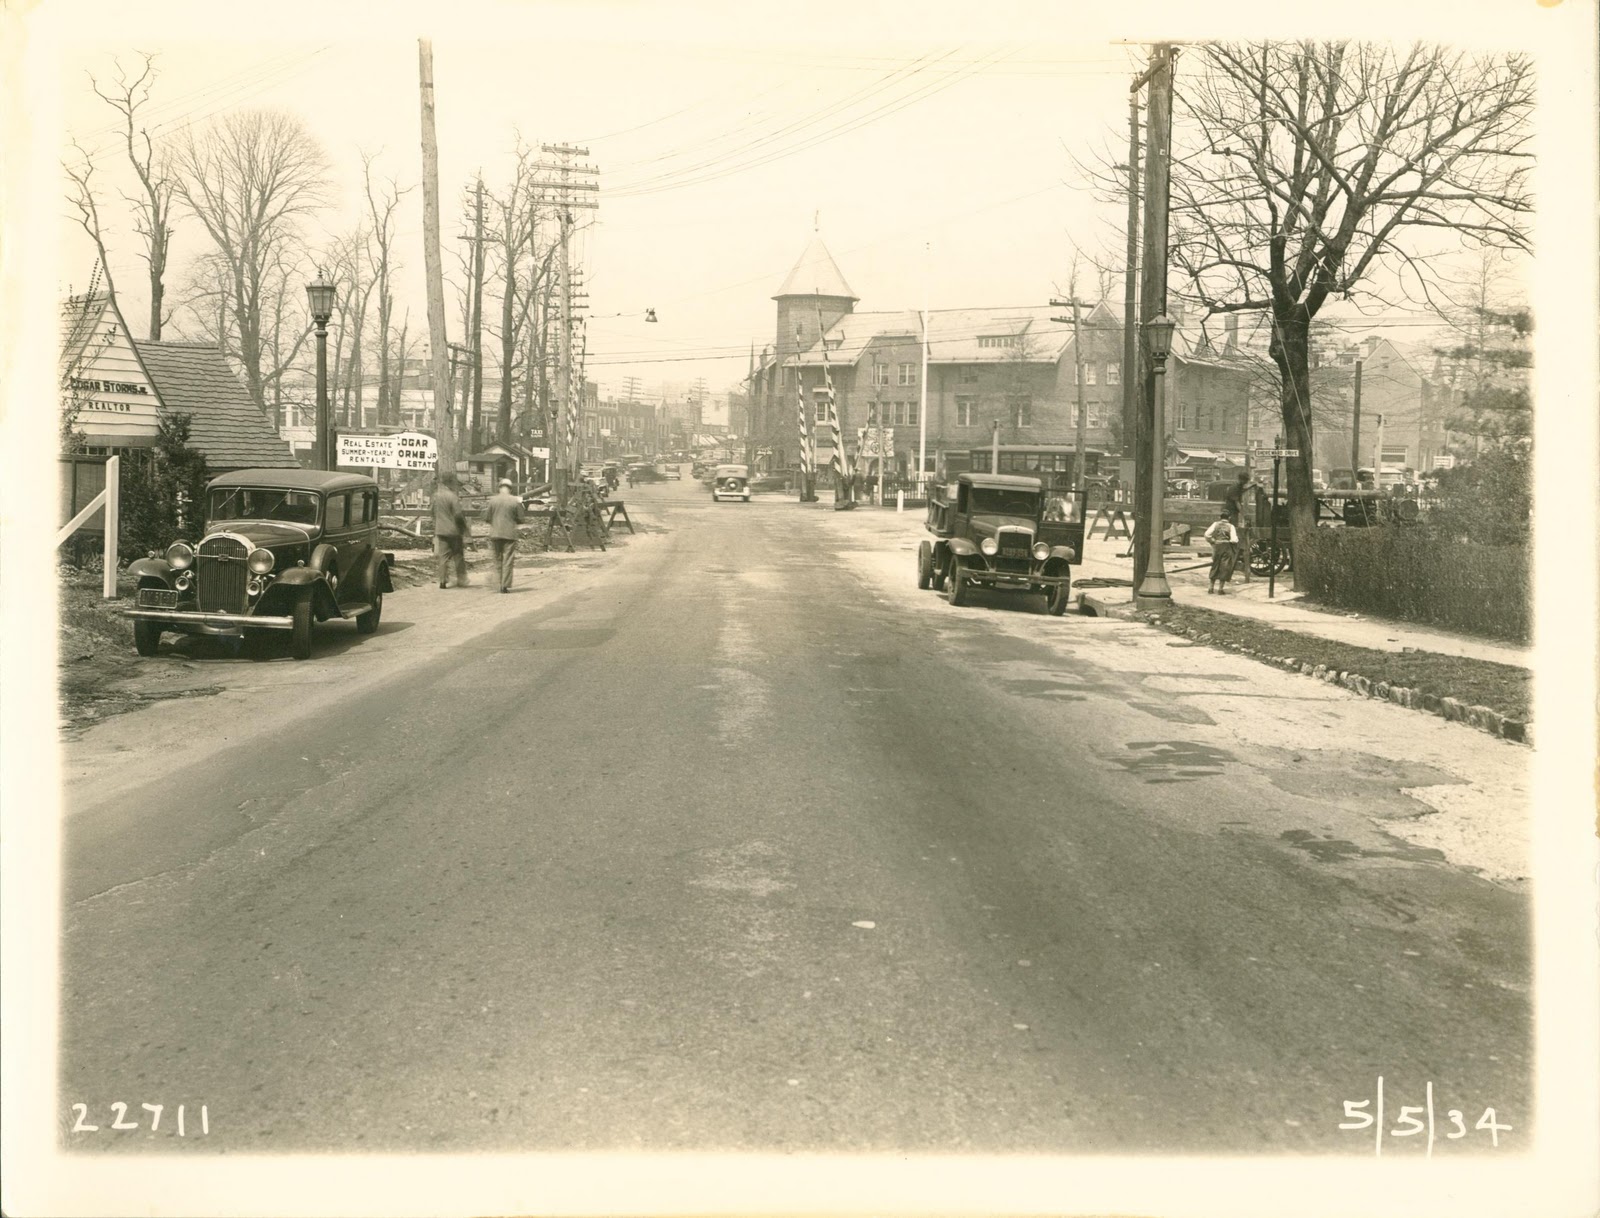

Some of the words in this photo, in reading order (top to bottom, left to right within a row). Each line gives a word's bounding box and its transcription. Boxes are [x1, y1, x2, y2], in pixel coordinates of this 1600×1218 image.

[103, 381, 137, 394] STORMS
[88, 401, 131, 412] REALTOR
[343, 439, 362, 447] REAL
[365, 440, 392, 448] ESTATE
[341, 448, 393, 456] SUMMER-YEARLY
[398, 450, 425, 459] ORMS
[349, 456, 386, 464] RENTALS
